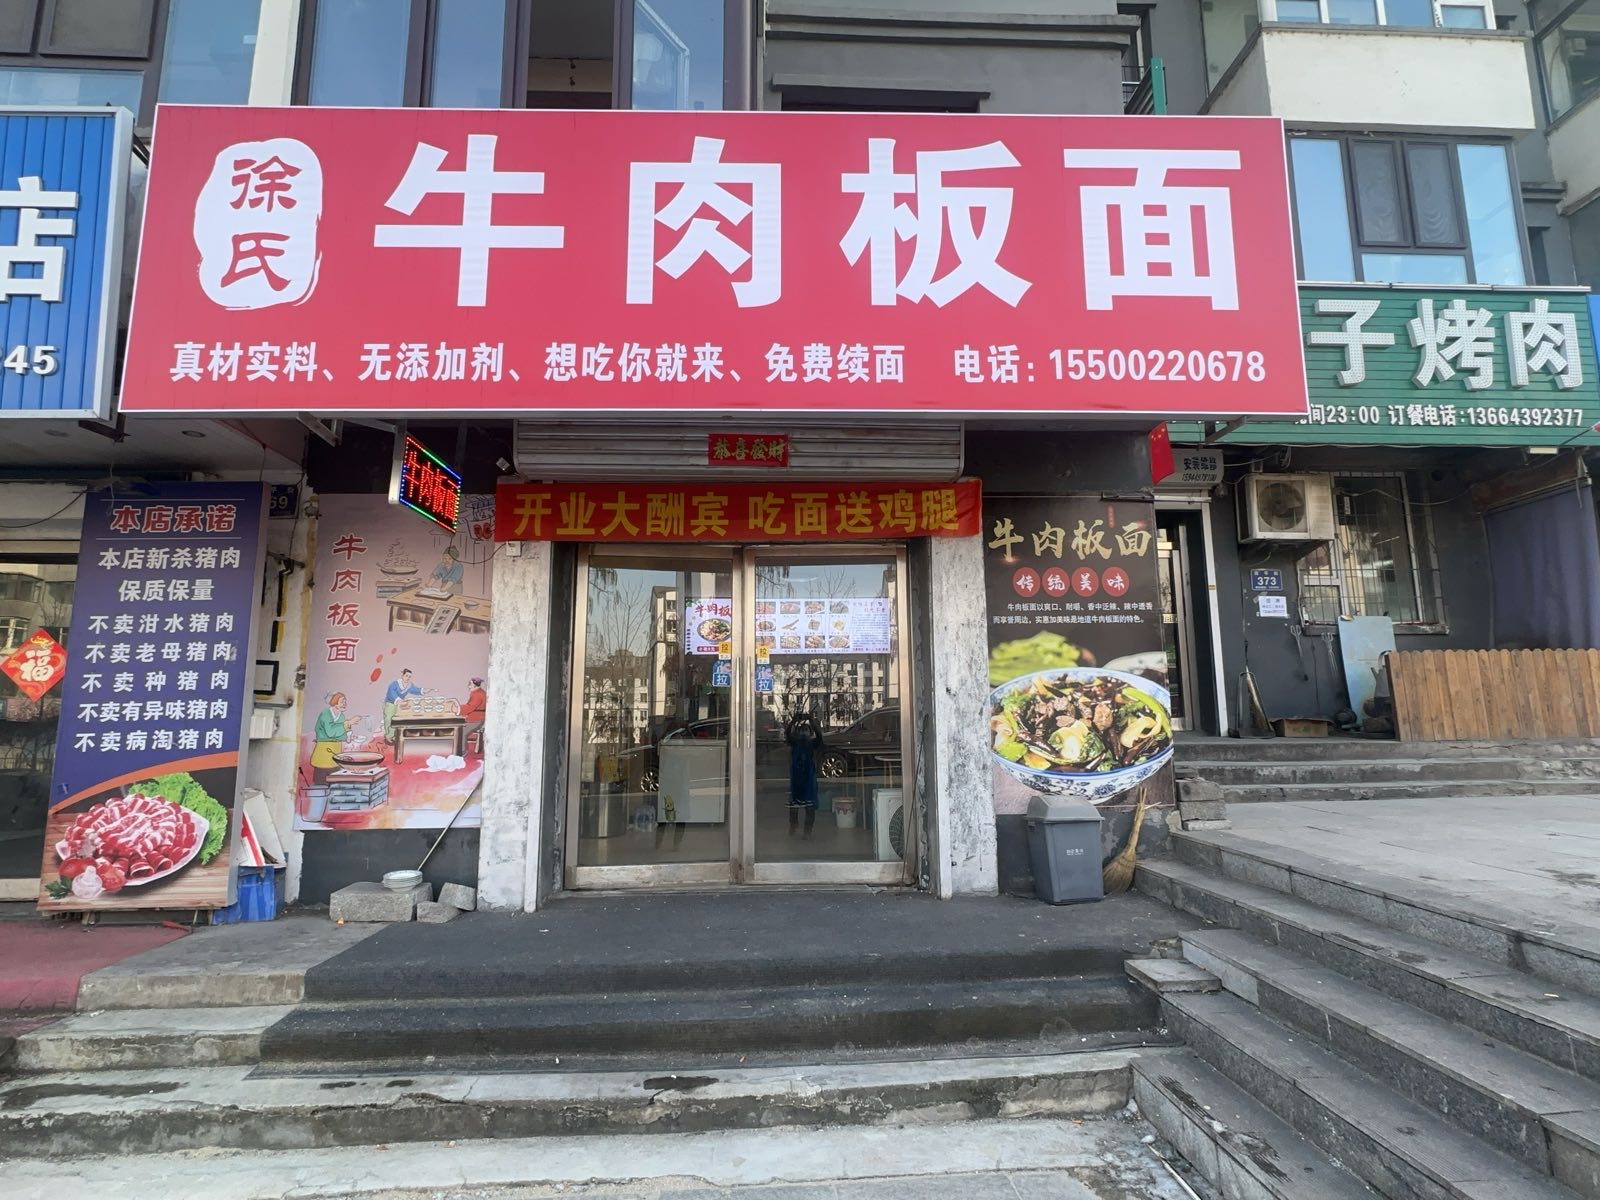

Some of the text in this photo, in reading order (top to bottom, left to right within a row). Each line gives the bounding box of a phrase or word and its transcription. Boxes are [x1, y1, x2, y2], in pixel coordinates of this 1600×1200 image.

[220, 156, 303, 291] 徐氏
[373, 134, 1241, 311] 牛肉板面
[0, 176, 79, 302] 店
[1307, 298, 1583, 391] 子烤肉
[404, 450, 459, 524] 牛肉板面
[110, 505, 237, 533] 本店承诺
[513, 488, 960, 537] 开业大酬宾 吃面送鸡腿
[988, 517, 1152, 562] 牛肉板面
[98, 547, 241, 570] 本店新杀猪肉
[118, 579, 215, 602] 保质保量
[1257, 576, 1277, 586] 373
[326, 533, 368, 663] 牛肉板面
[88, 612, 234, 635] 不卖泔水猪肉
[20, 649, 54, 682] 福
[84, 641, 231, 664] 不卖老母猪肉
[81, 669, 230, 693] 不卖种猪肉
[716, 673, 728, 686] 拉
[758, 679, 771, 691] 拉
[77, 699, 228, 723] 不卖有异味猪肉
[74, 728, 224, 752] 不卖病淘猪肉
